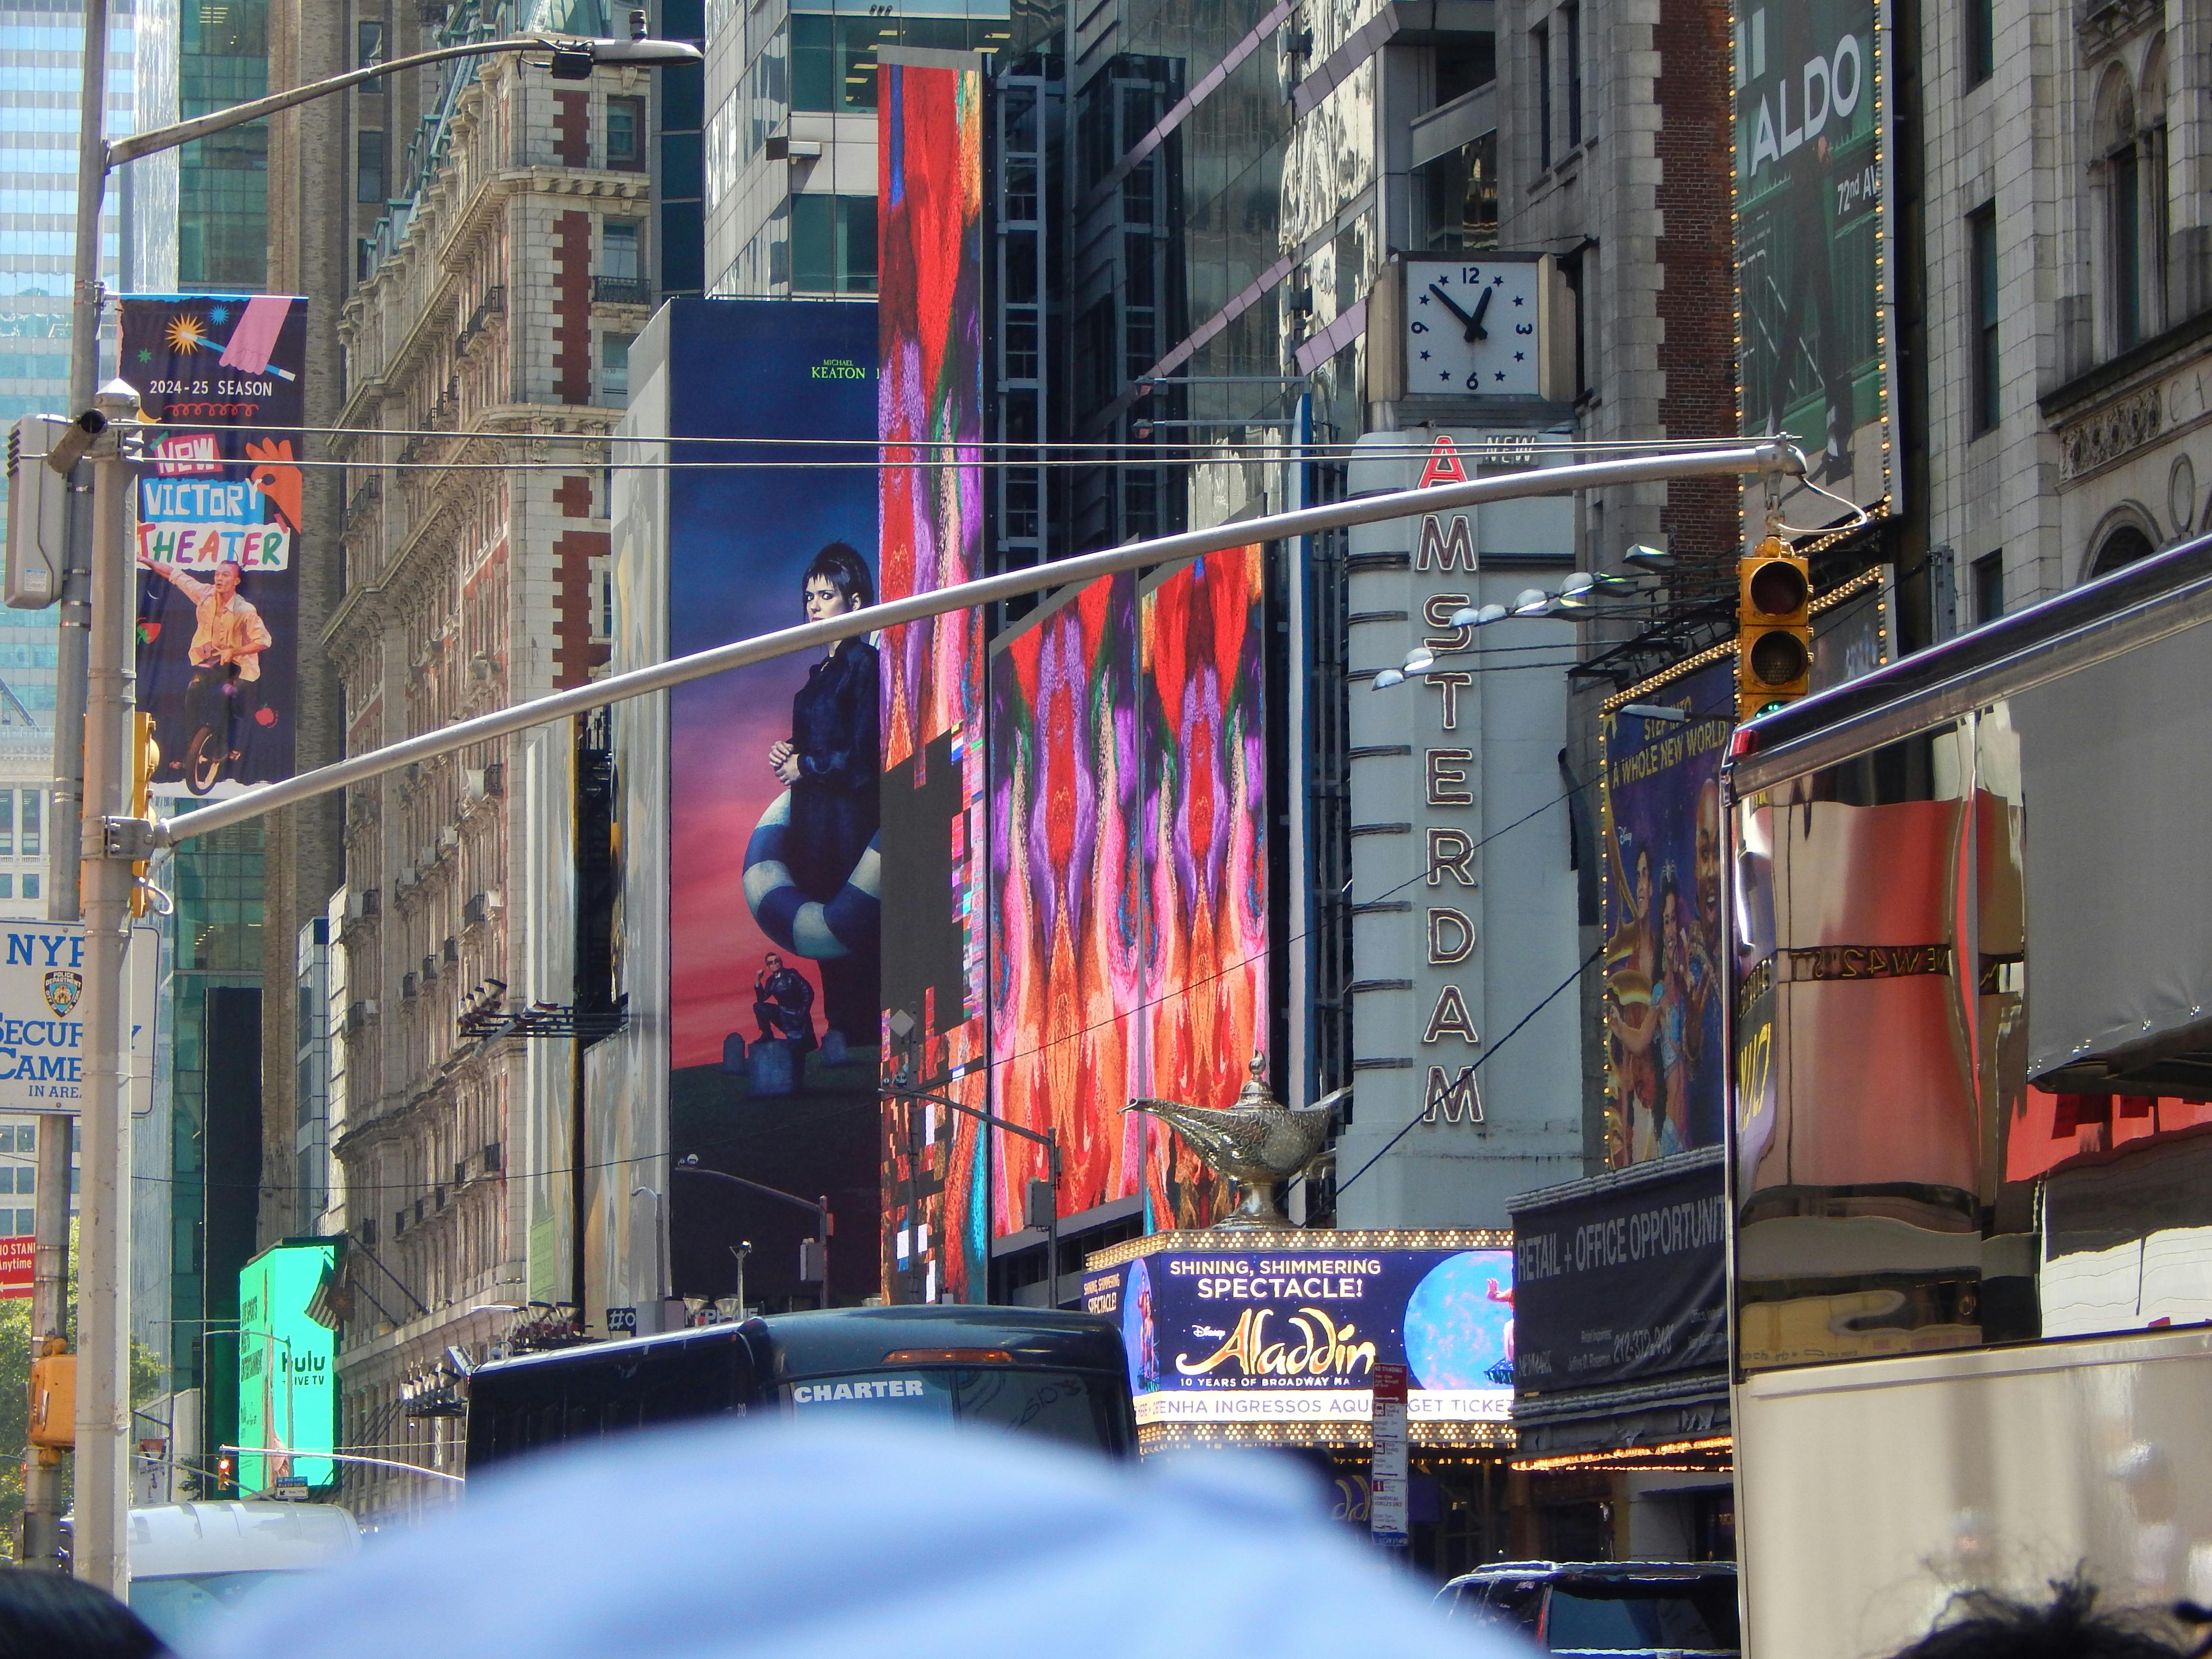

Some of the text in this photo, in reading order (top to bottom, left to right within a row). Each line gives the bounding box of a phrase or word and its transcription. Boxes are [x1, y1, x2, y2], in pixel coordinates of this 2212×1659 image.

[1750, 34, 1862, 177] ALDO
[1837, 172, 1860, 215] 72nd
[1462, 267, 1480, 284] 12
[1515, 323, 1533, 335] 3
[811, 366, 866, 379] KEATON
[1466, 372, 1479, 390] 6
[149, 380, 273, 397] 2024-25 SEASON
[1484, 434, 1535, 464] NEW
[145, 478, 263, 517] VICTORY
[136, 523, 283, 565] THEATER
[1612, 760, 1620, 790] A
[1622, 745, 1659, 784] WHOLE
[1660, 733, 1684, 770] NEW
[1415, 434, 1485, 1124] AMSTERDAM
[6, 933, 85, 967] NYP
[45, 977, 82, 988] DEPARTMENT
[0, 1046, 82, 1082] CAME
[29, 1085, 82, 1099] IN ARE
[11, 1242, 36, 1255] STAN
[1517, 1233, 1561, 1283] RETAIL
[1575, 1217, 1627, 1272] OFFICE
[1630, 1195, 1726, 1261] OPPORTUNIT
[1169, 1259, 1381, 1277] SHINING, SHIMMERING
[1197, 1277, 1363, 1298] SPECTACLE!
[1175, 1307, 1376, 1376] Aladdin
[281, 1350, 325, 1372] hulu
[294, 1376, 309, 1385] IVE
[312, 1375, 324, 1385] TV
[1180, 1378, 1193, 1387] 10
[1197, 1377, 1237, 1387] YEARS
[1240, 1377, 1257, 1386] OF
[1262, 1376, 1330, 1386] BROADWAY
[793, 1380, 924, 1403] CHARTER
[1215, 1399, 1322, 1413] INGRESSOS
[1329, 1399, 1369, 1414] AQU
[1408, 1398, 1443, 1413] GET
[1451, 1399, 1514, 1413] TICKET
